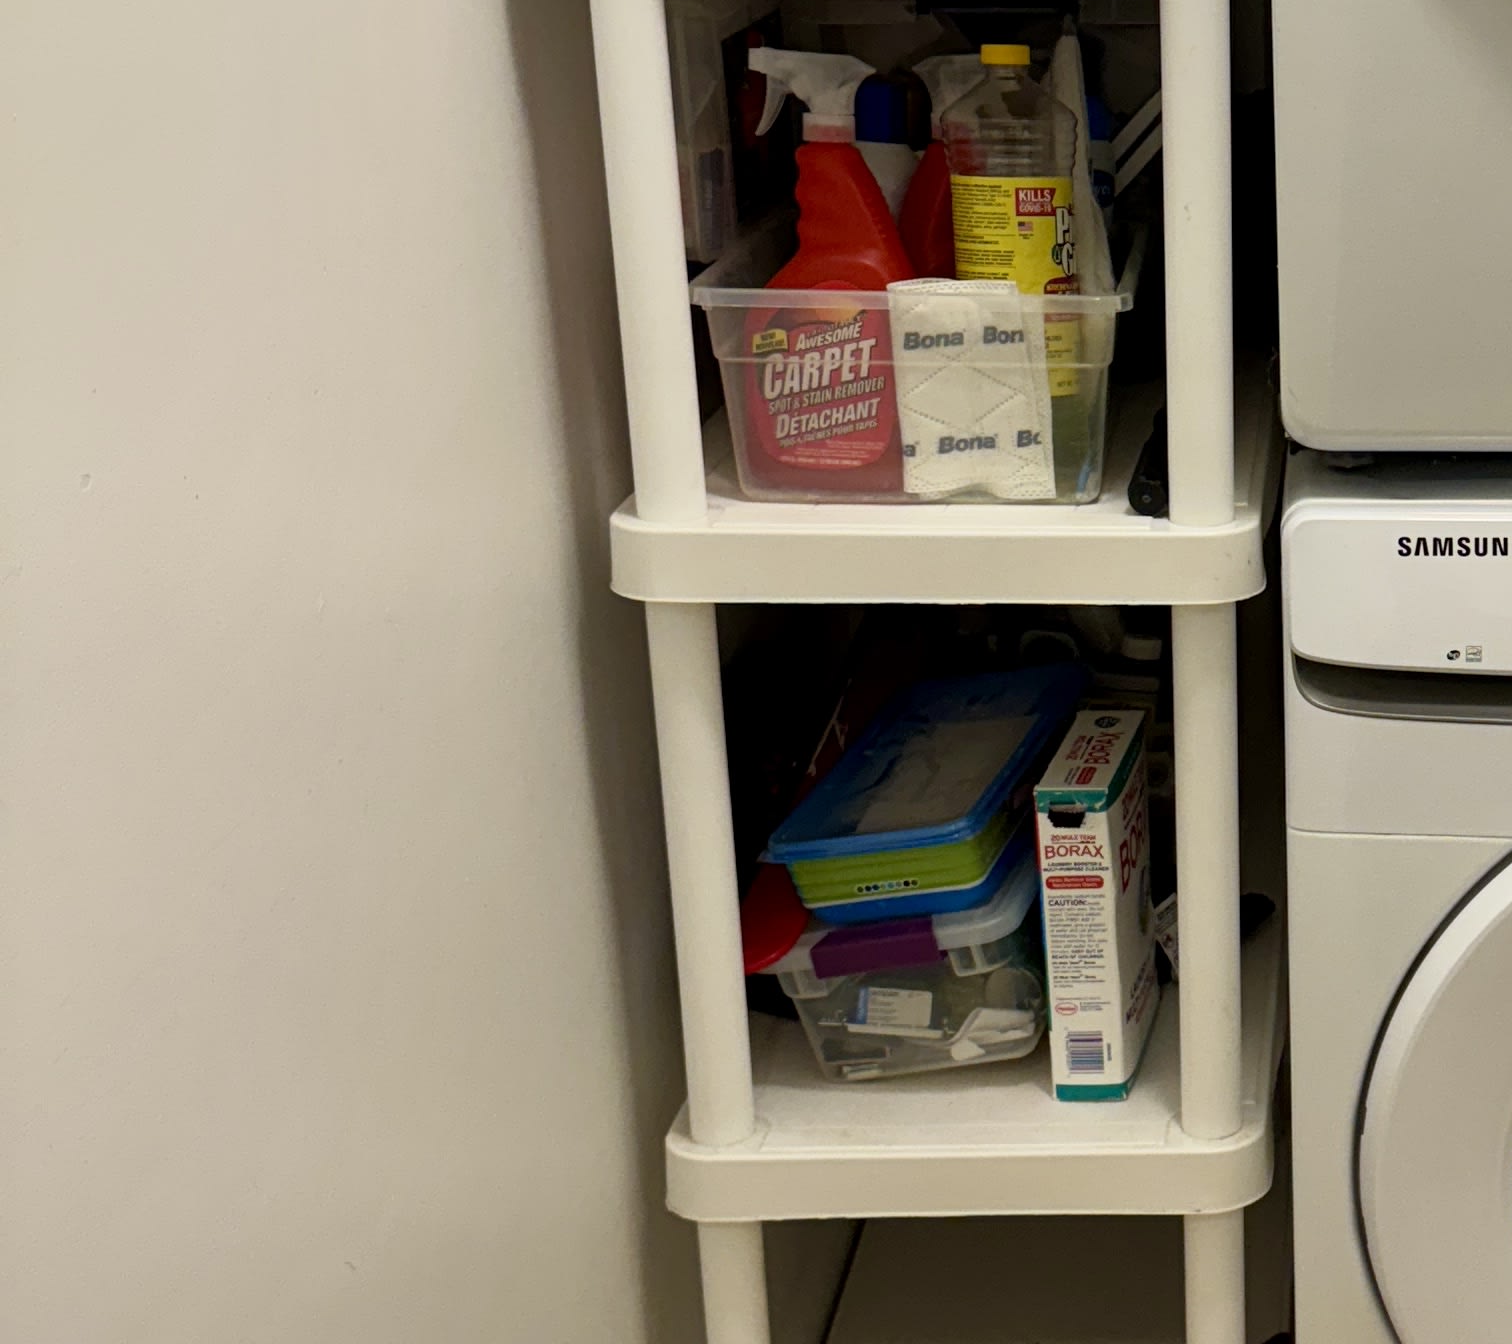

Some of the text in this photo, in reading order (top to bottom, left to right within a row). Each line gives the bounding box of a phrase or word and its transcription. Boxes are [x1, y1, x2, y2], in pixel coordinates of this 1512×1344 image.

[1018, 189, 1051, 202] KILLS
[795, 321, 863, 352] AWESOME
[904, 331, 965, 350] Bona
[764, 338, 877, 400] CARPET
[768, 398, 791, 415] SPOT
[802, 387, 833, 407] STAIN
[834, 376, 885, 400] REMOVER
[776, 397, 881, 439] DÉTACHANT
[938, 435, 998, 455] Bona
[1044, 845, 1104, 860] BORAX
